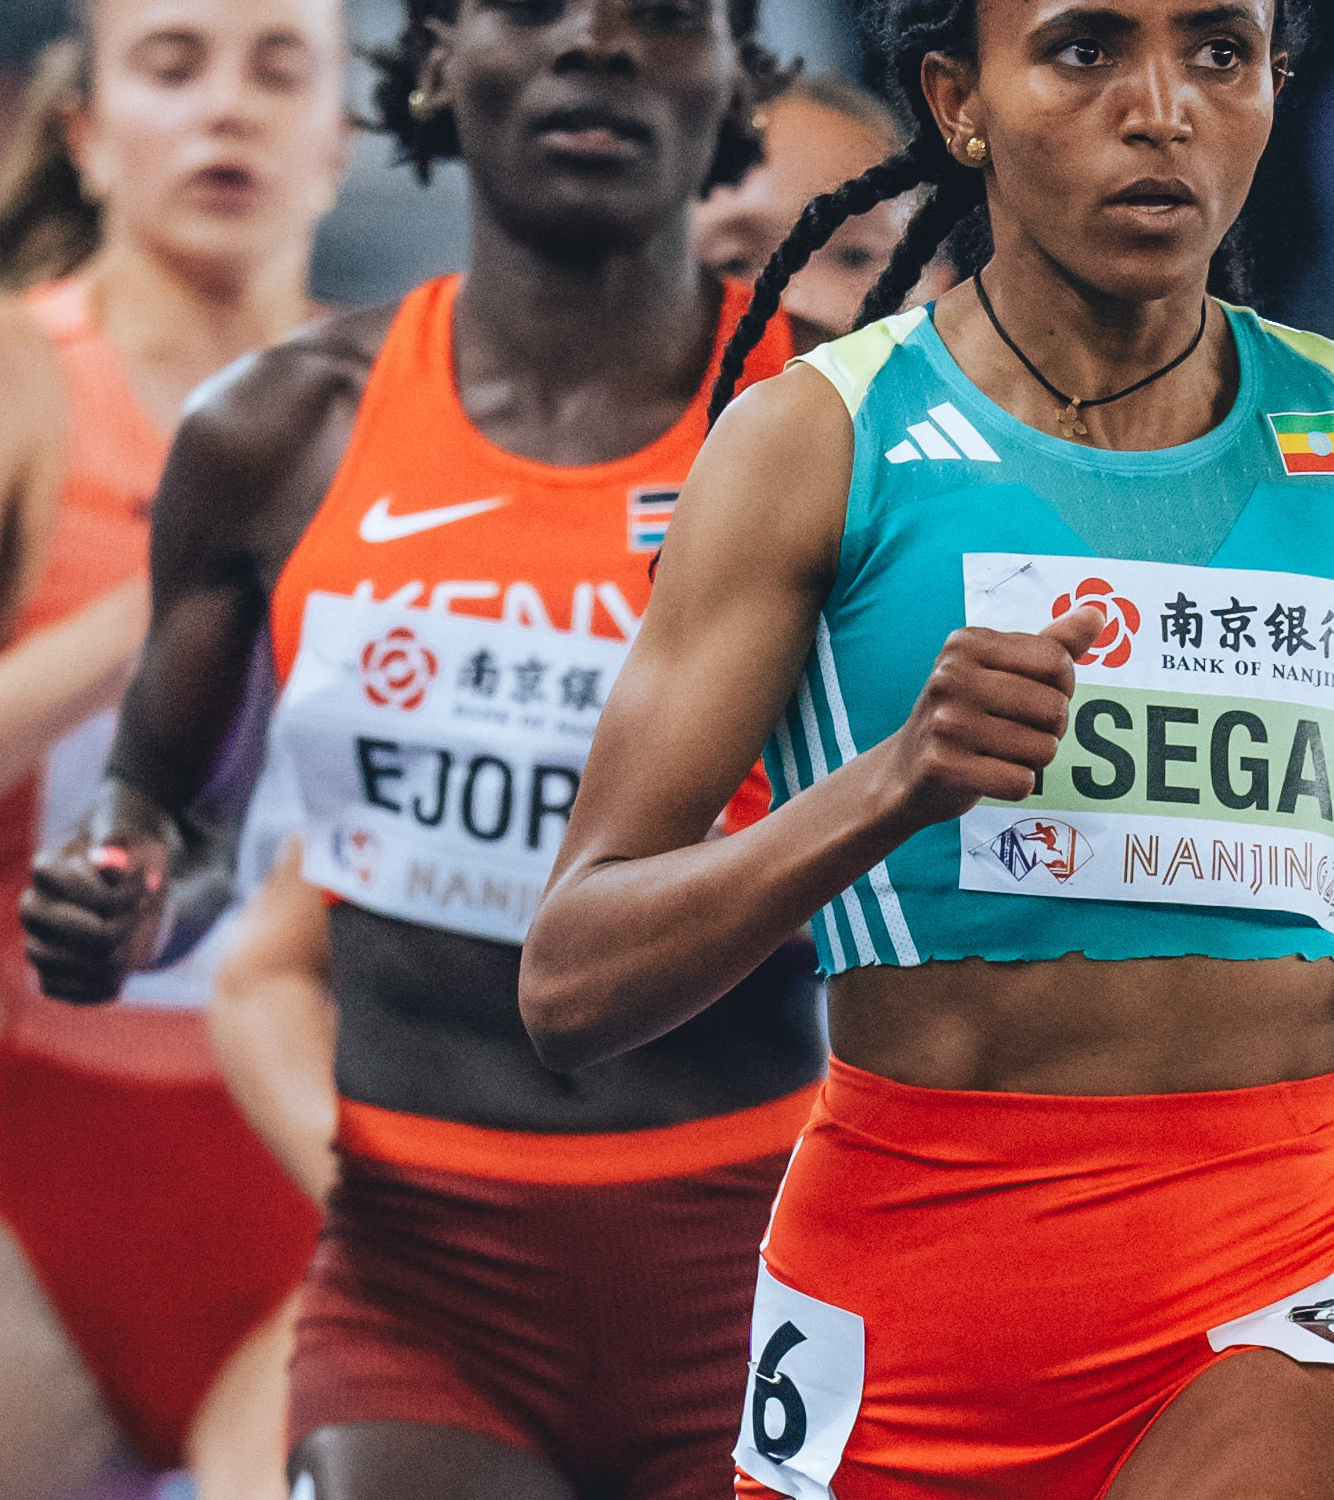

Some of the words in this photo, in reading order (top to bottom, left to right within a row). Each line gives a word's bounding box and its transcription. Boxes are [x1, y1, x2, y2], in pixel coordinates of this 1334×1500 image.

[1162, 654, 1225, 674] BANK
[1235, 660, 1262, 676] OF
[354, 734, 584, 852] EJOR
[753, 1320, 809, 1466] 6
